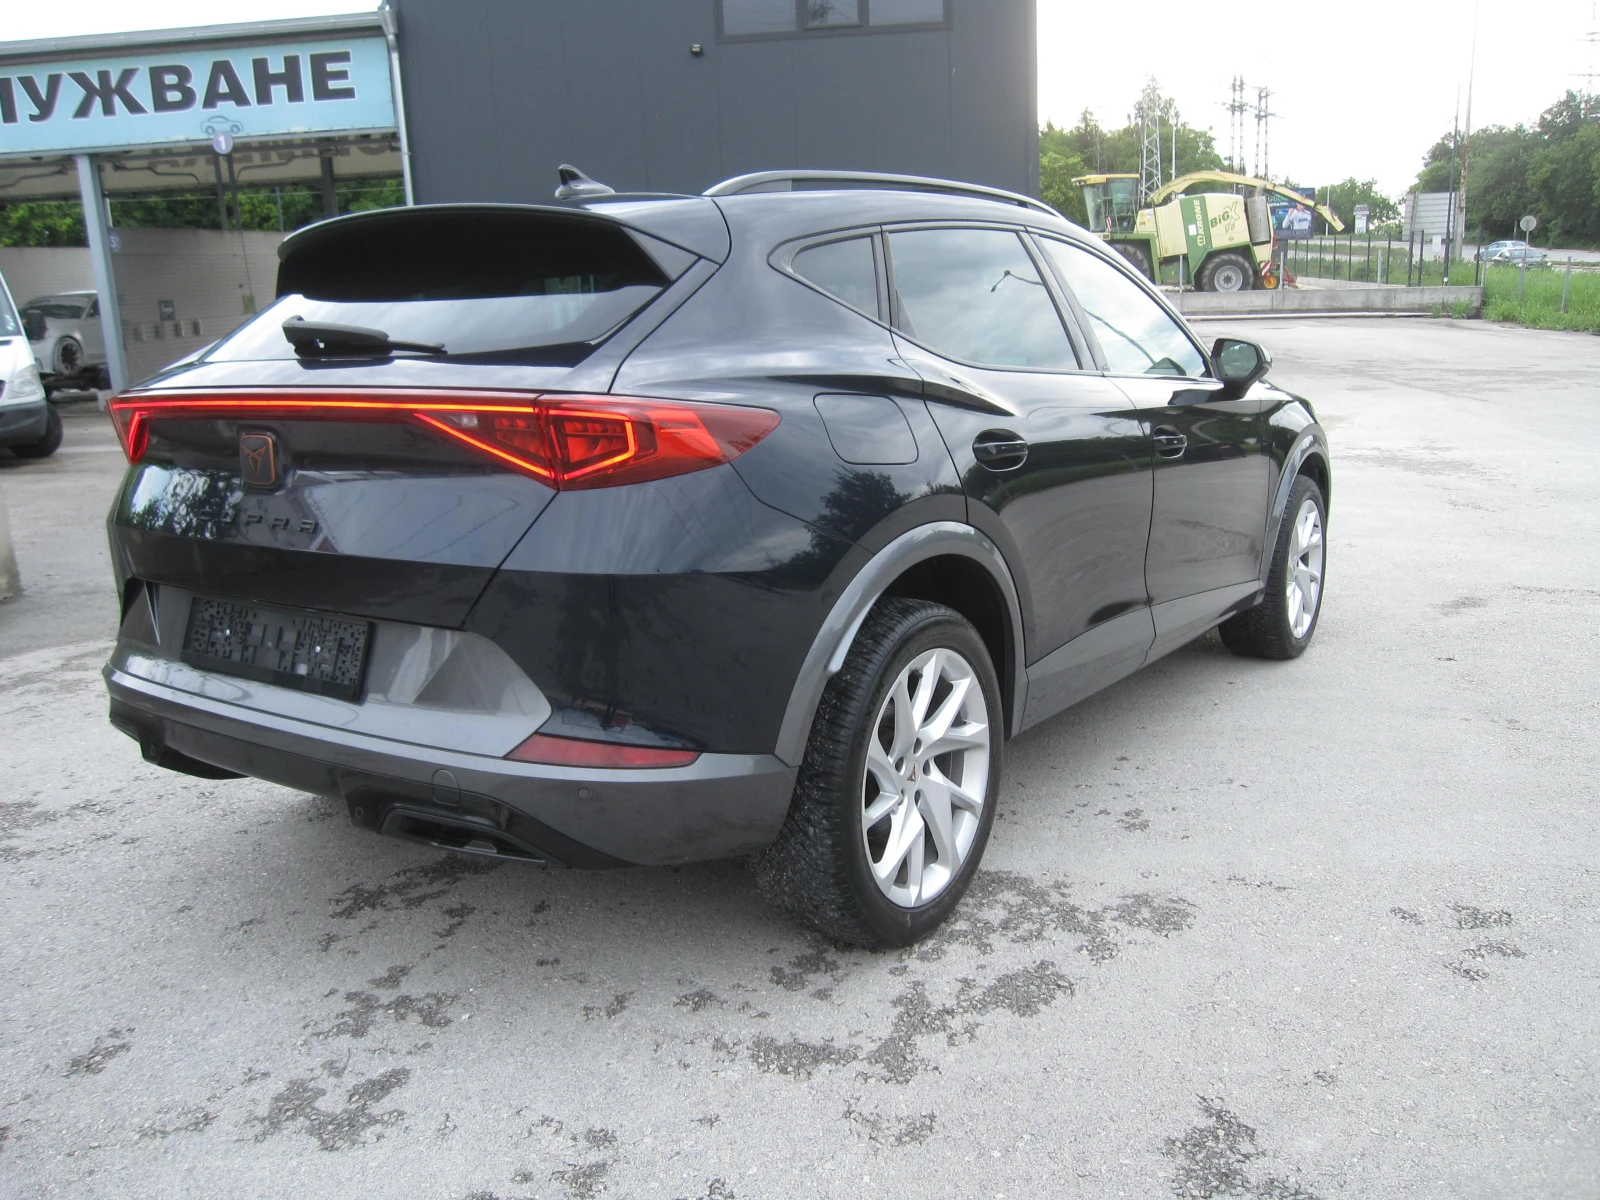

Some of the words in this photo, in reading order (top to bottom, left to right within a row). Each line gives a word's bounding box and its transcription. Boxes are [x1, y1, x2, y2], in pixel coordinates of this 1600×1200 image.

[217, 135, 228, 151] 1
[1193, 199, 1205, 235] KRONE
[199, 508, 319, 534] CUPRA
